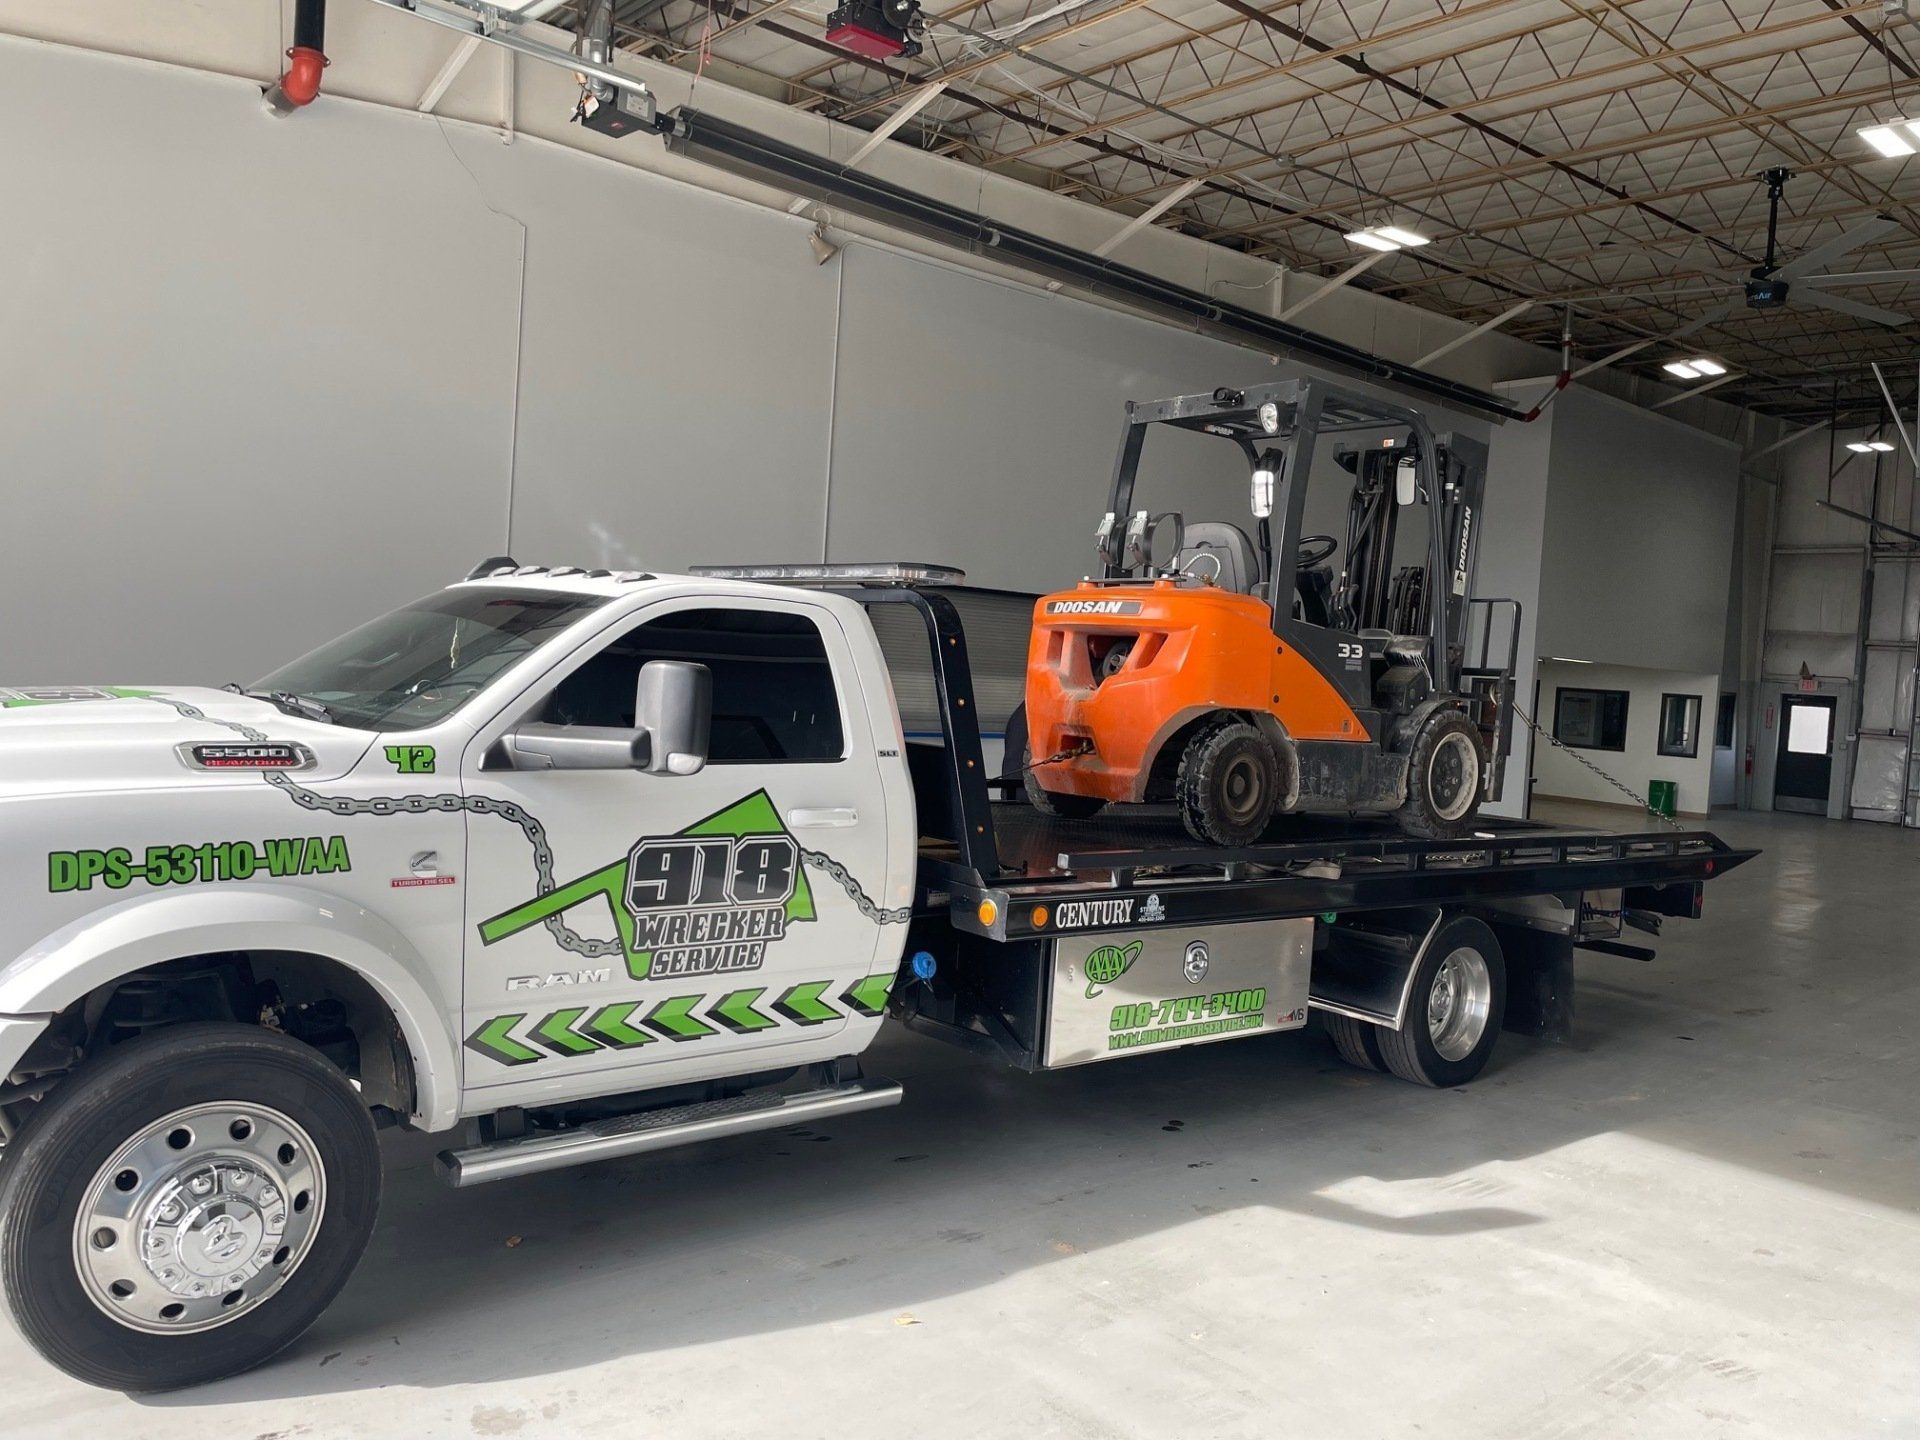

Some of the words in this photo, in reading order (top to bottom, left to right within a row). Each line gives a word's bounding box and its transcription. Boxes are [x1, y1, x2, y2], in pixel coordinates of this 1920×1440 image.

[1459, 505, 1472, 571] DOOSAN
[1053, 601, 1123, 614] DOOSAN
[1337, 643, 1363, 658] 33
[202, 748, 290, 757] 5500
[255, 758, 293, 766] DUTY
[383, 745, 436, 774] 42
[48, 836, 351, 892] DPS-53110-WAA
[630, 837, 796, 908] 918
[1055, 899, 1134, 928] CENTURY
[635, 910, 784, 949] WRECKER
[655, 942, 763, 974] SERVICE
[1088, 948, 1123, 981] AAA
[506, 968, 611, 991] RAM
[1109, 987, 1266, 1031] 918-794-3400
